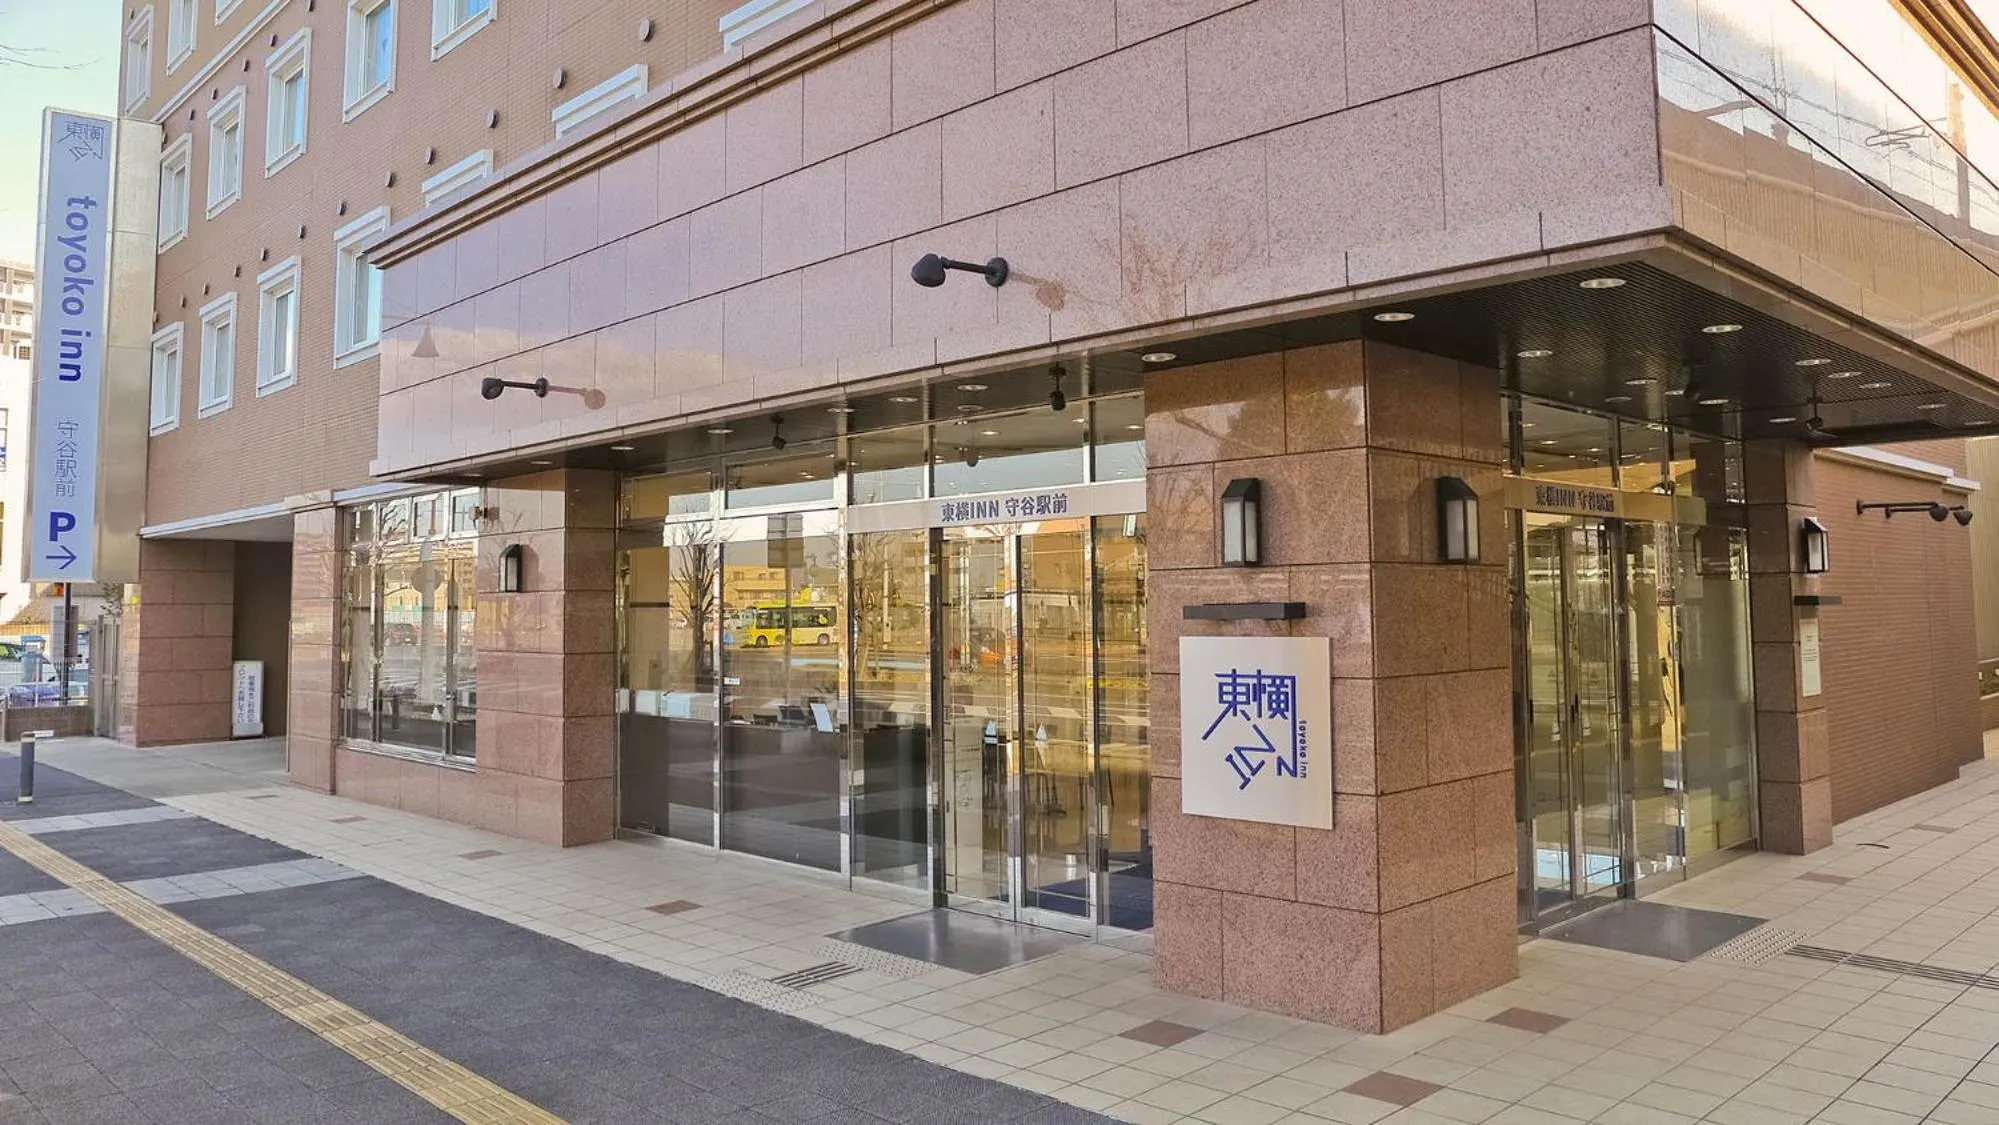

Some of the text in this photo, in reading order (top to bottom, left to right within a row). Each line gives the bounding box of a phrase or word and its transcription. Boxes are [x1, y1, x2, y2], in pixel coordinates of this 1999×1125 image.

[57, 195, 97, 382] toyoko inn
[55, 418, 79, 498] 守谷駅前
[49, 511, 77, 542] P
[941, 492, 1068, 522] 東横INN 守谷駅前
[1298, 720, 1308, 779] toyoko inn
